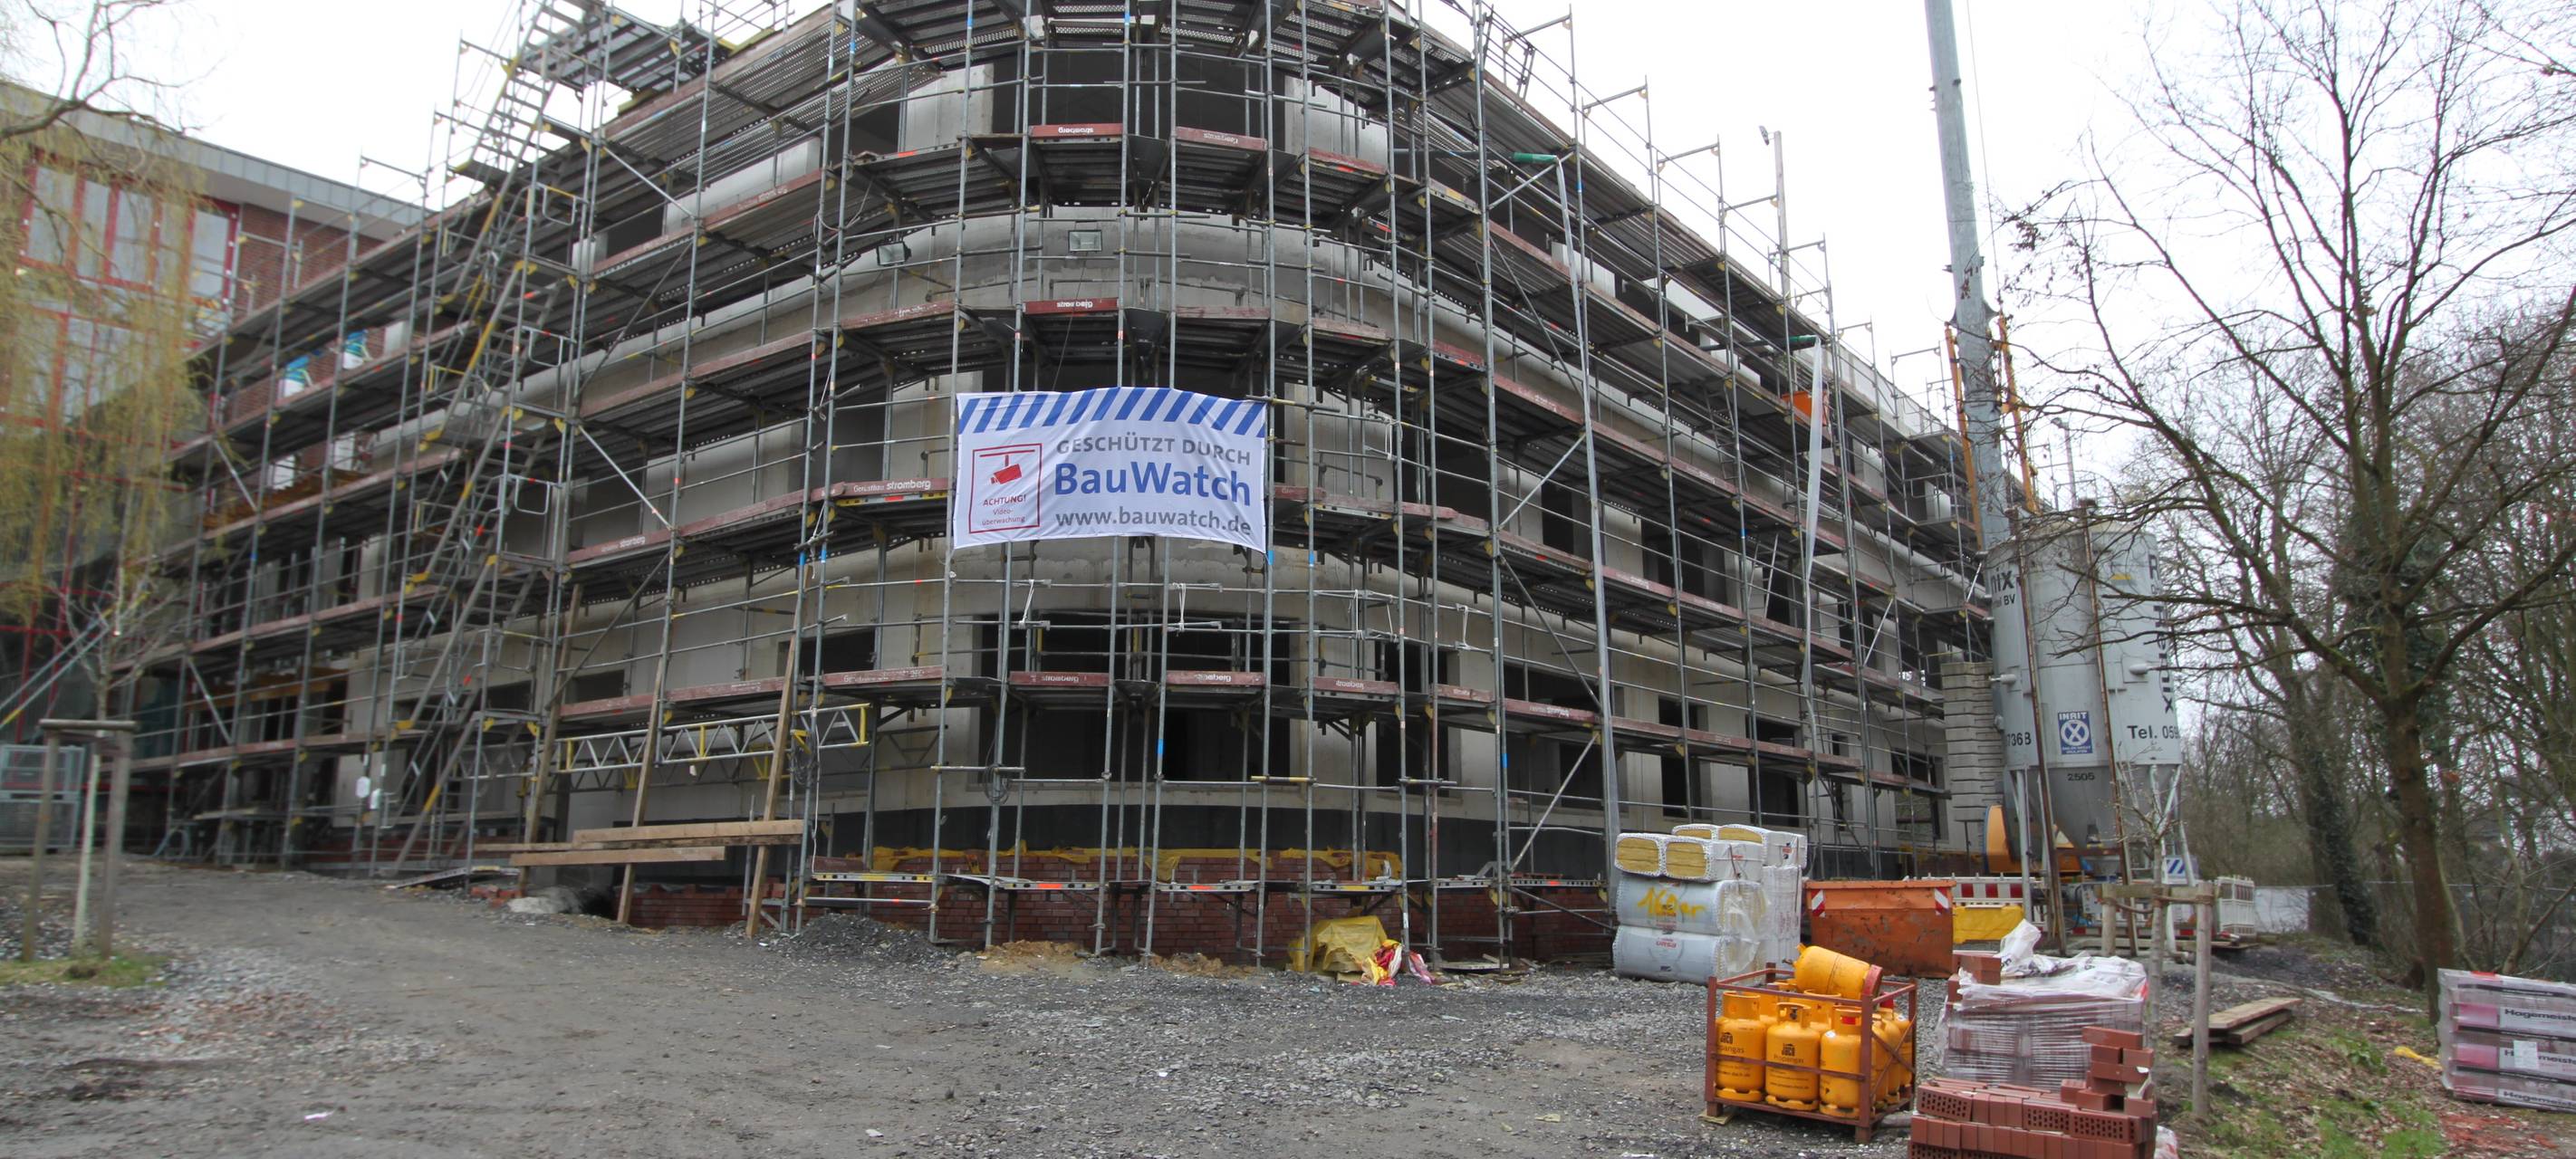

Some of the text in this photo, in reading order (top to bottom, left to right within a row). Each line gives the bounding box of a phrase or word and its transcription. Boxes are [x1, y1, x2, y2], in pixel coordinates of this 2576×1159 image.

[1056, 432, 1251, 465] GESCHÜTZT DURCH
[1054, 461, 1251, 507] BauWatch
[983, 494, 1026, 506] ACHTUNG!
[1055, 506, 1252, 535] www.bauwatch.de
[2004, 594, 2015, 606] BV
[2126, 724, 2158, 740] Tel.
